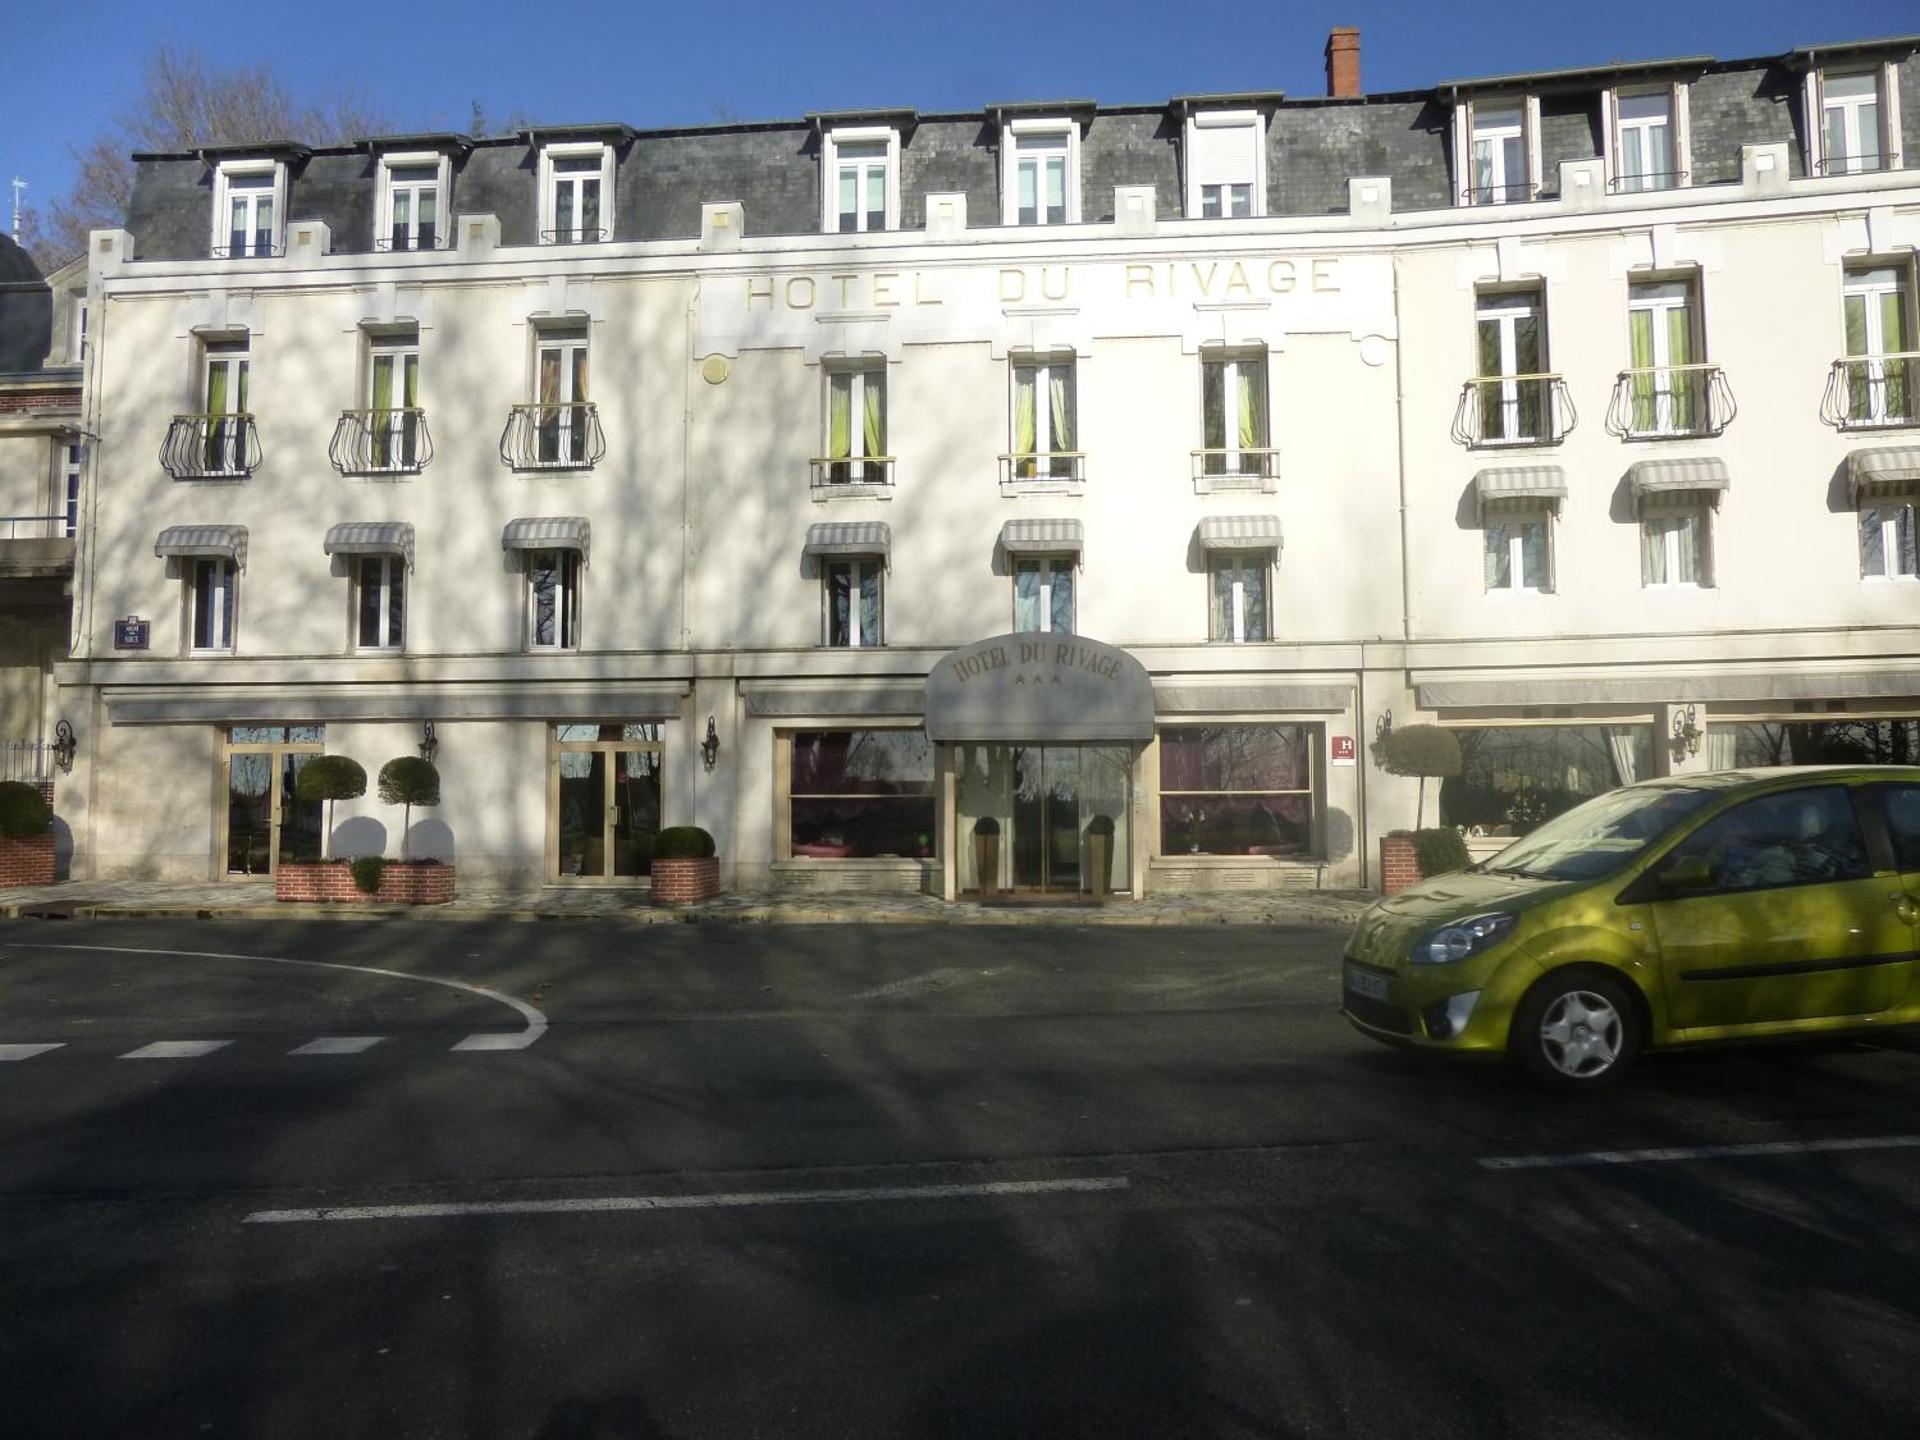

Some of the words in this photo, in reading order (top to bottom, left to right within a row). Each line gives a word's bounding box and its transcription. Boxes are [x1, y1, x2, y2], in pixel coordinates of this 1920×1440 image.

[748, 272, 943, 311] HOTEL
[999, 268, 1069, 302] DU
[1126, 259, 1341, 298] RIVAGE
[953, 647, 1011, 682] HOTEL
[1020, 642, 1045, 663] DU
[1055, 643, 1122, 681] RIVAGE
[1342, 740, 1352, 750] H
